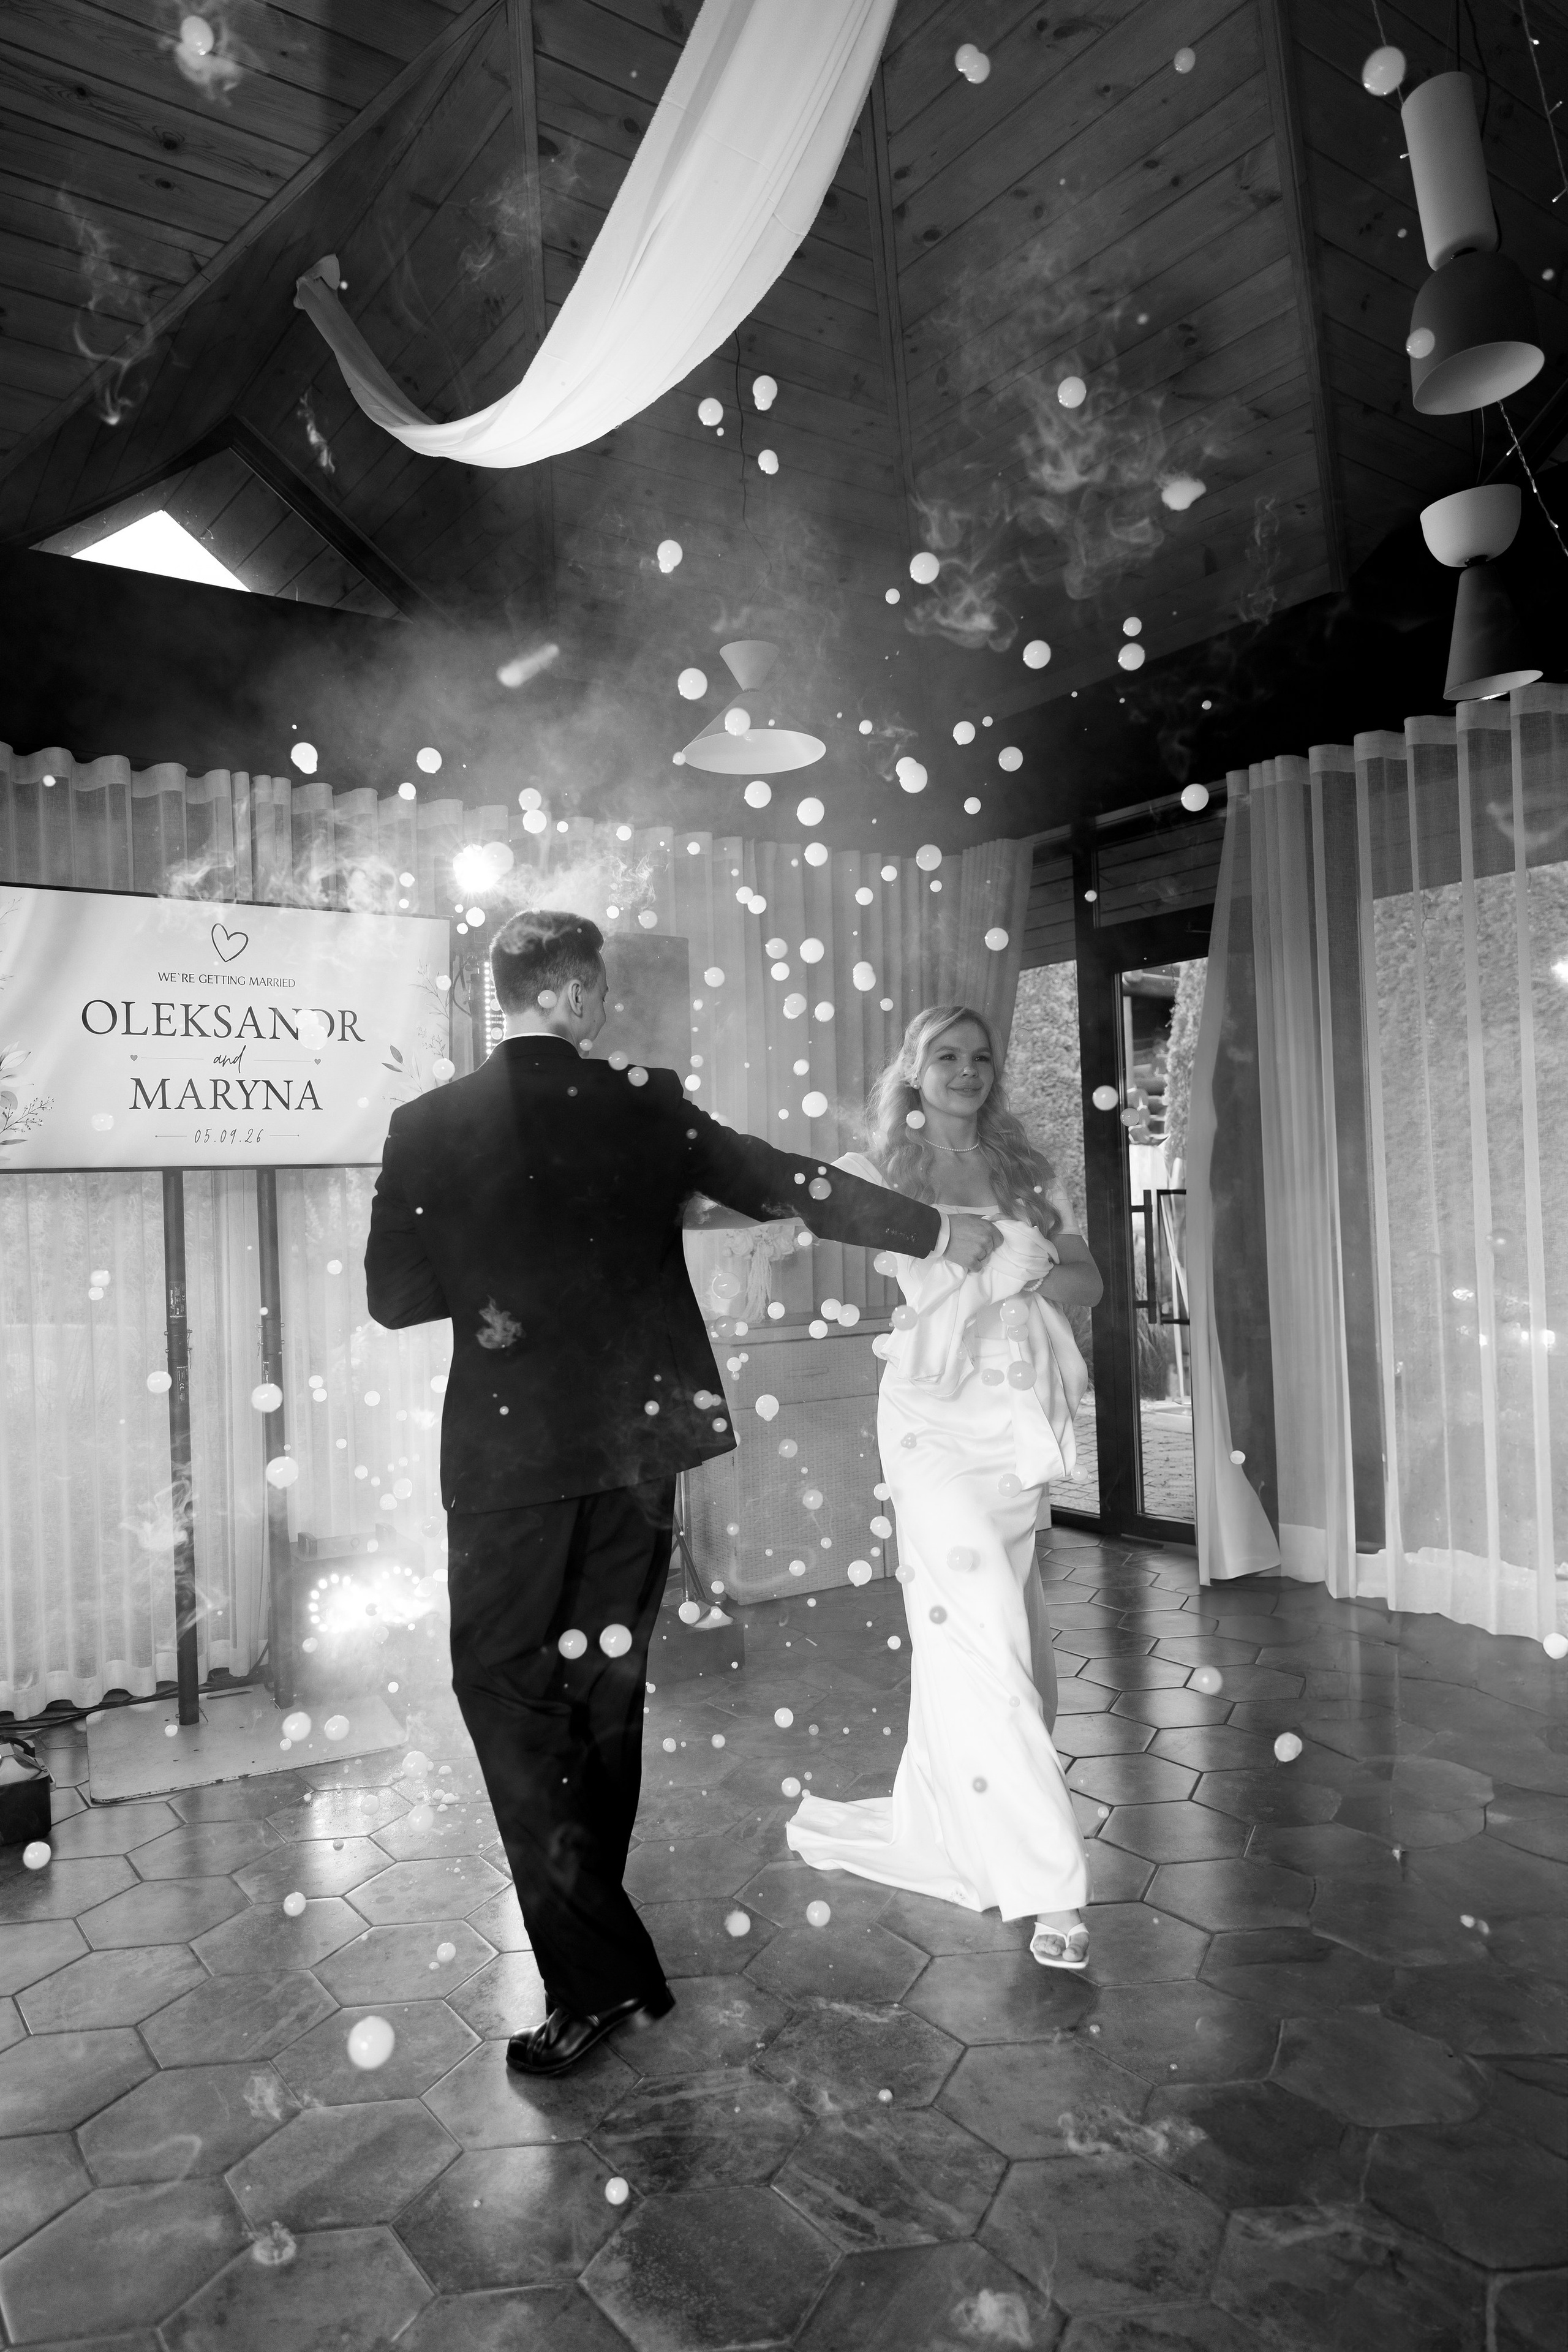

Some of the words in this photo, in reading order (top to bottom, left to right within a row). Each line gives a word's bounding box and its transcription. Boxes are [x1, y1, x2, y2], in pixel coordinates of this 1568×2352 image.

[198, 974, 246, 986] GETTING
[249, 976, 296, 988] MARRIED
[213, 1045, 247, 1074] and
[129, 1077, 324, 1110] MARYNA
[194, 1128, 264, 1144] 05.09.26
